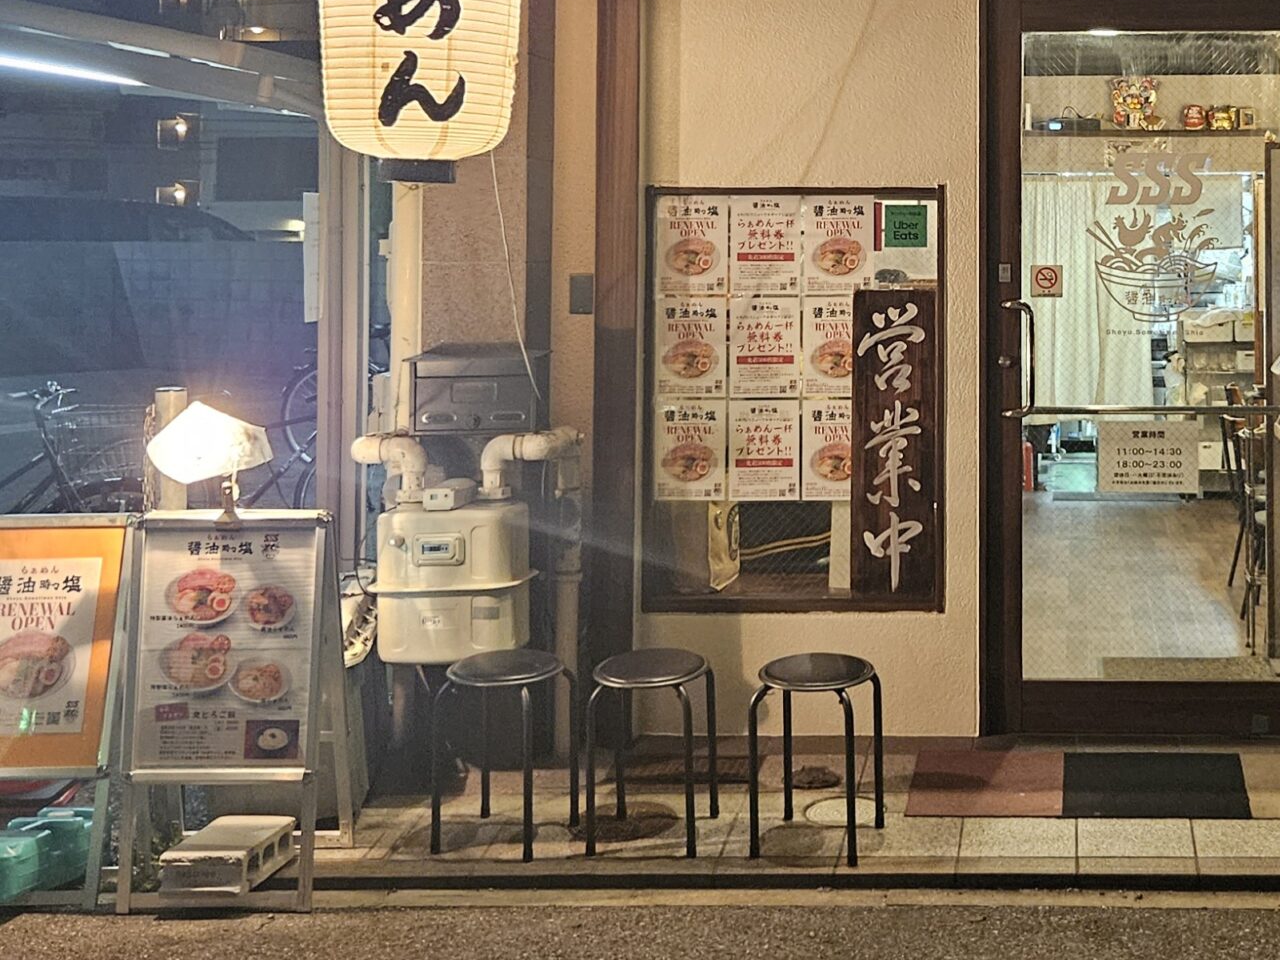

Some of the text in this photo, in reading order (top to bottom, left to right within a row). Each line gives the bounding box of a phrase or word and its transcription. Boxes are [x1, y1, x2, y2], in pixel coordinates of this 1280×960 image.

[1105, 153, 1211, 205] SSS
[669, 220, 717, 230] RENEWAL
[736, 218, 795, 228] らぁめん一杯
[815, 220, 863, 230] RENEWAL
[893, 220, 919, 230] Uber
[680, 229, 706, 238] OPEN
[826, 229, 852, 238] OPEN
[893, 230, 919, 241] Eats
[667, 323, 715, 332] RENEWAL
[736, 321, 794, 331] らぁめん一杯
[678, 331, 704, 340] OPEN
[666, 426, 714, 435] RENEWAL
[735, 424, 793, 433] らぁめん一杯
[677, 434, 703, 443] OPEN
[1131, 430, 1166, 439] 営業時間
[856, 302, 926, 592] 営業中
[187, 541, 254, 556] 醤油時々塩
[11, 616, 57, 632] OPEN
